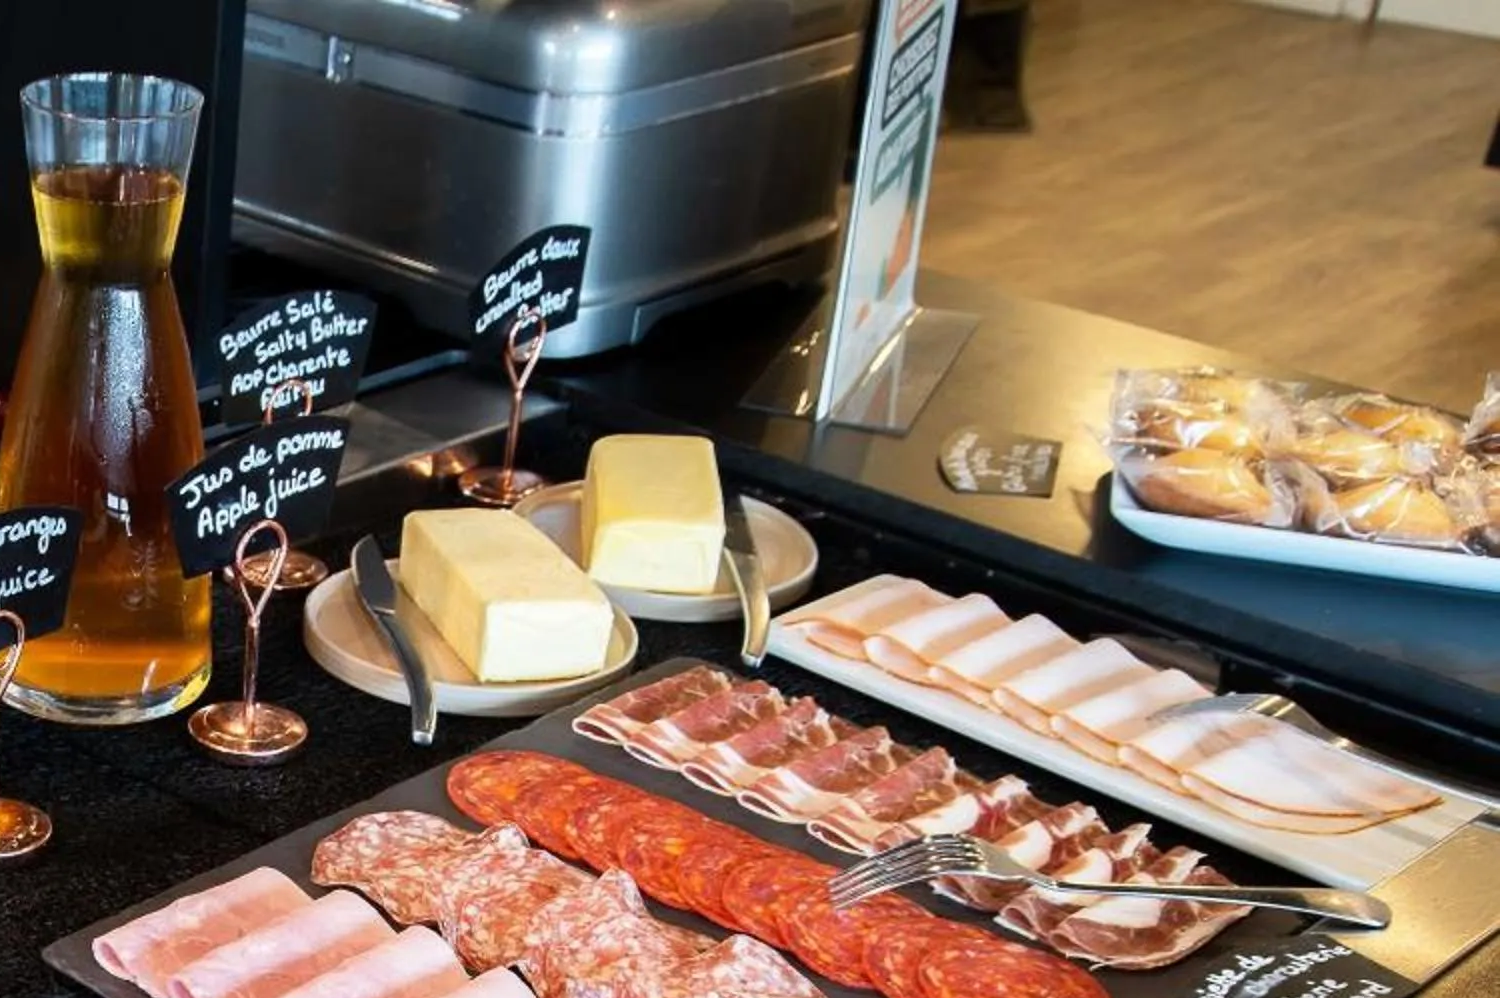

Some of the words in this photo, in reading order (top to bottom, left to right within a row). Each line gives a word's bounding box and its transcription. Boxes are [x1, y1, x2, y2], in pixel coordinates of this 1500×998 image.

[220, 310, 282, 360] Beurre
[286, 290, 335, 325] Salé
[254, 331, 307, 365] Salty
[310, 313, 368, 344] Butter
[179, 466, 233, 510] Jus
[239, 444, 273, 473] de
[277, 429, 345, 465] pomme
[197, 485, 261, 538] Apple
[264, 466, 327, 518] juice
[1235, 954, 1276, 972] de
